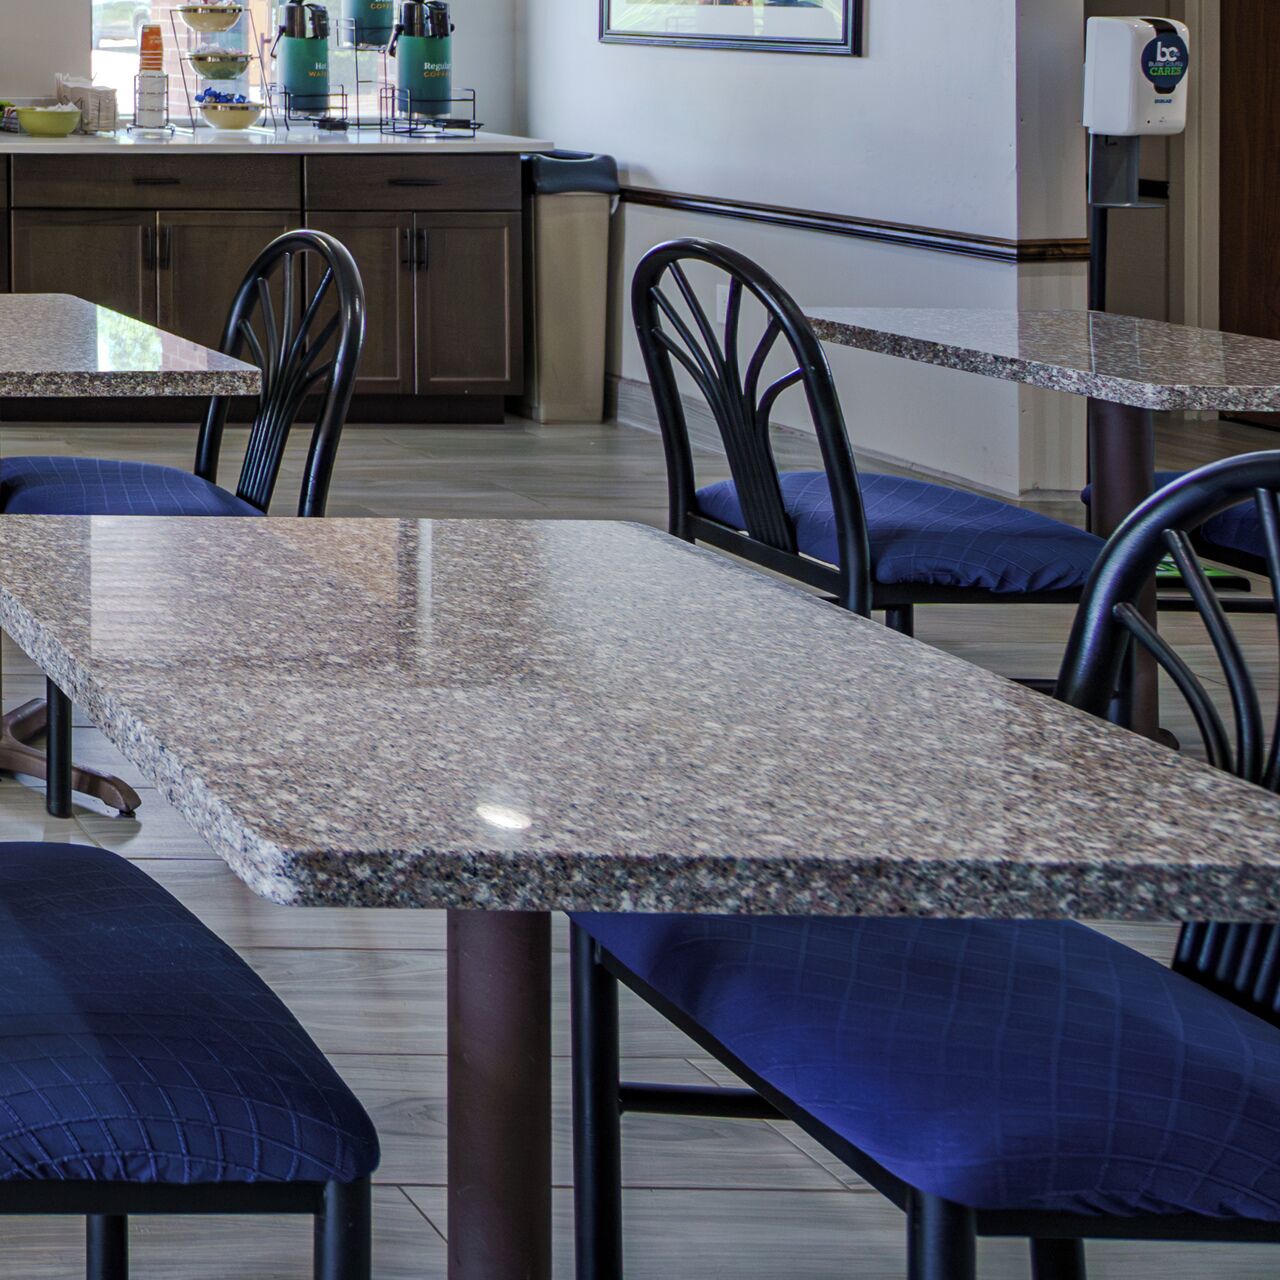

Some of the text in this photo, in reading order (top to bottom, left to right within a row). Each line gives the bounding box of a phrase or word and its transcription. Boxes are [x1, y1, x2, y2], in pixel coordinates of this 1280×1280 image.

[370, 2, 393, 10] COFF
[423, 62, 451, 71] Regula
[1149, 66, 1182, 76] CARES
[423, 70, 449, 79] COFF
